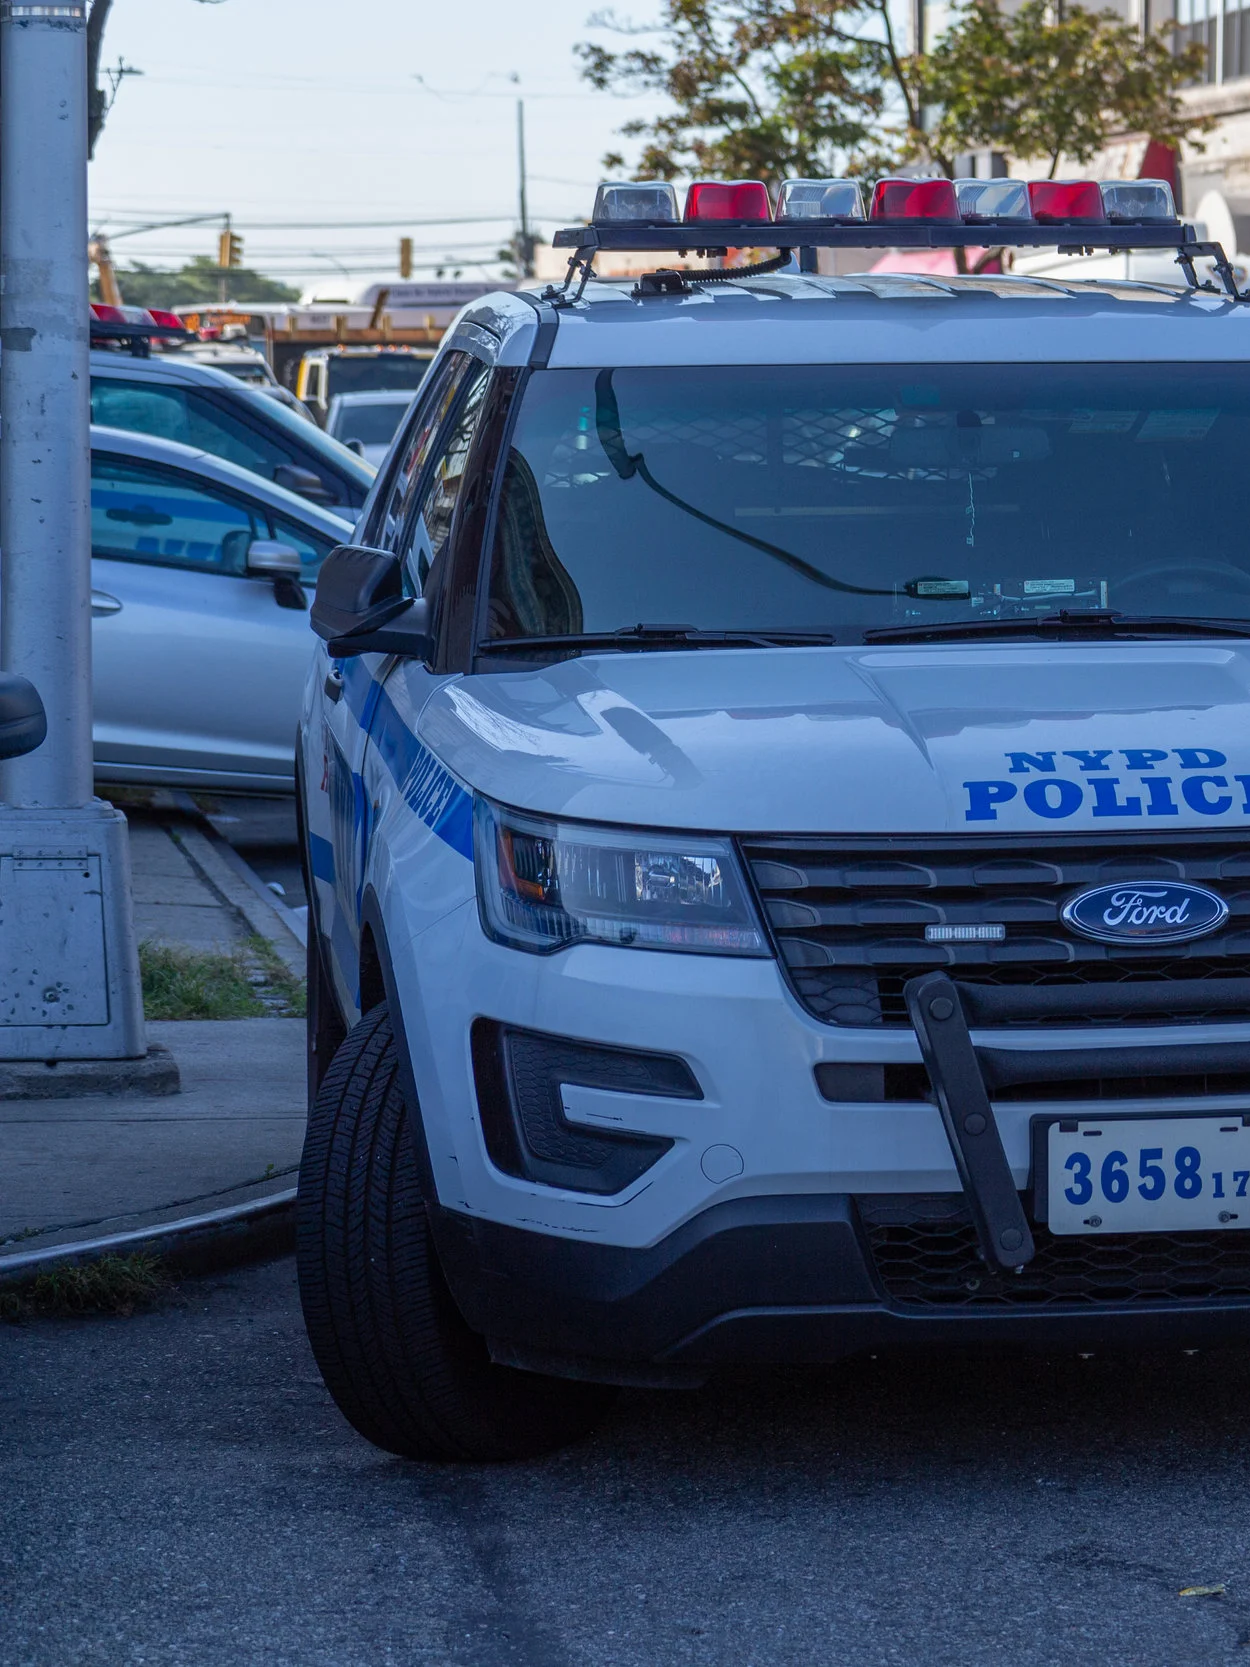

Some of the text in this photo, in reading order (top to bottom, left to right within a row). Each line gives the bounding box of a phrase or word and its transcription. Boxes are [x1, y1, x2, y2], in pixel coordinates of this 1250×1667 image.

[1004, 748, 1227, 773] NYPD
[401, 746, 457, 830] POLICE
[1103, 890, 1191, 926] Ford
[1063, 1146, 1250, 1206] 3658 17
